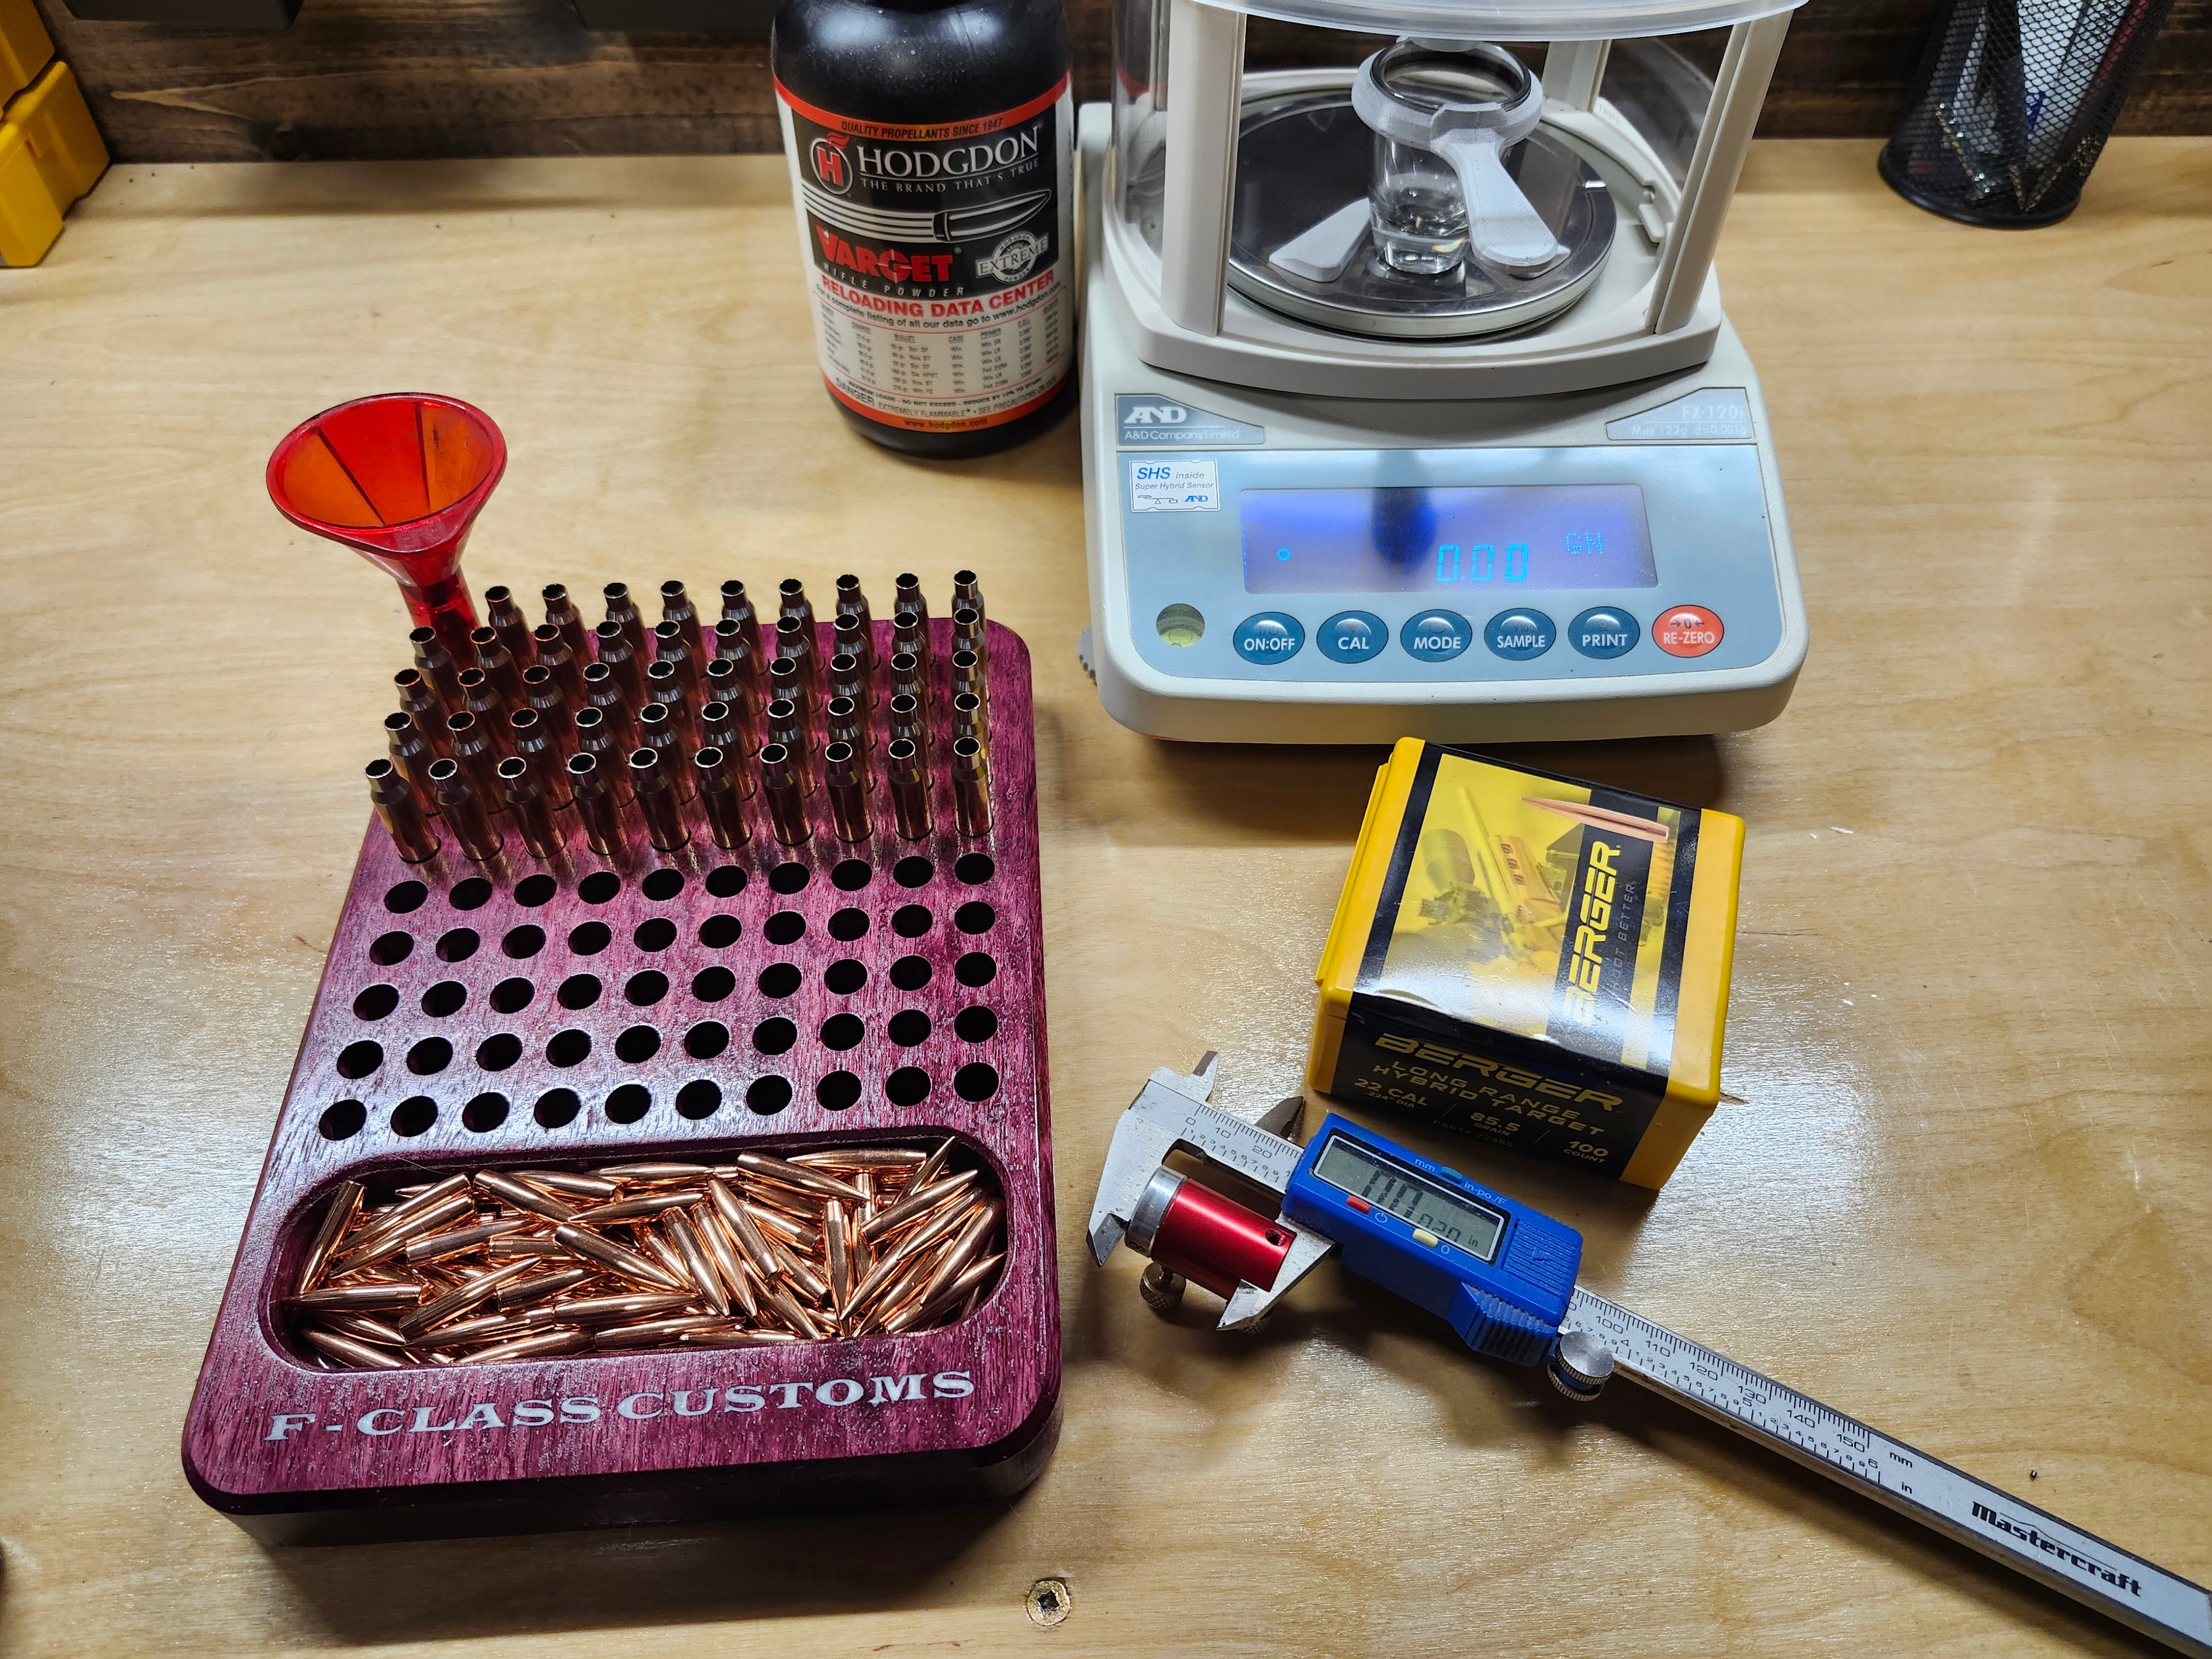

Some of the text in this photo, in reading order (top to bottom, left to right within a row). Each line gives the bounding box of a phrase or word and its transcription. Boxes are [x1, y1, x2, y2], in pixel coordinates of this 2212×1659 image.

[842, 118, 1003, 139] QUALITY PROPELLANTS SINCE 1947
[857, 126, 1039, 177] HODGDON
[861, 158, 1039, 193] THE BRAND THAT'S TRUE
[816, 225, 953, 283] VARGET
[980, 238, 1047, 274] EXTREME
[823, 262, 964, 298] RIFLE POWDER
[821, 269, 1055, 317] RELOADING DATA CENTER
[867, 312, 895, 327] listing
[910, 320, 921, 328] all
[967, 318, 979, 327] go
[982, 316, 991, 324] to
[878, 402, 919, 416] EXTREMELY
[1682, 405, 1744, 419] FX-120i
[904, 419, 988, 430] www.hodgdon.com
[1660, 425, 1688, 437] 122g
[1124, 431, 1149, 440] A&D
[1205, 430, 1239, 440] Limited
[1137, 467, 1205, 480] SHS inside
[1135, 483, 1158, 491] Super
[1160, 482, 1185, 491] Hybrid
[1565, 532, 1604, 555] GN
[1244, 638, 1296, 651] ON:OFF
[1338, 637, 1370, 650] CAL
[1414, 637, 1461, 650] MODE
[1497, 635, 1546, 649] SAMPLE
[1582, 634, 1628, 647] PRINT
[1663, 631, 1715, 645] RE-ZERO
[1563, 840, 1621, 1027] BERGER
[1375, 1032, 1623, 1112] BERGER
[1354, 1078, 1429, 1106] 22 CAL
[1392, 1060, 1581, 1120] LONG RANGE
[1372, 1065, 1605, 1135] HYBRID TARGET
[1395, 1099, 1415, 1108] DIA
[1470, 1112, 1521, 1132] 85.5
[1474, 1123, 1510, 1137] GRAIN
[1185, 1117, 1272, 1159] 0 10 20
[1563, 1149, 1607, 1164] COUNT
[1569, 1141, 1609, 1157] 100
[1414, 1158, 1435, 1172] mm
[1468, 1235, 1479, 1248] in
[617, 1370, 975, 1420] CUSTOMS
[1596, 1316, 1624, 1334] 100
[1645, 1340, 1671, 1357] 110
[1689, 1362, 1718, 1381] 120
[1737, 1385, 1767, 1404] 130
[1786, 1410, 1815, 1429] 140
[1836, 1433, 1865, 1453] 150
[1889, 1451, 1913, 1469] mm
[1743, 1397, 1752, 1407] 5
[1820, 1441, 1828, 1449] 6
[1868, 1458, 1878, 1469] 6
[1901, 1482, 1912, 1494] in
[1972, 1501, 2142, 1597] Mastercraft
